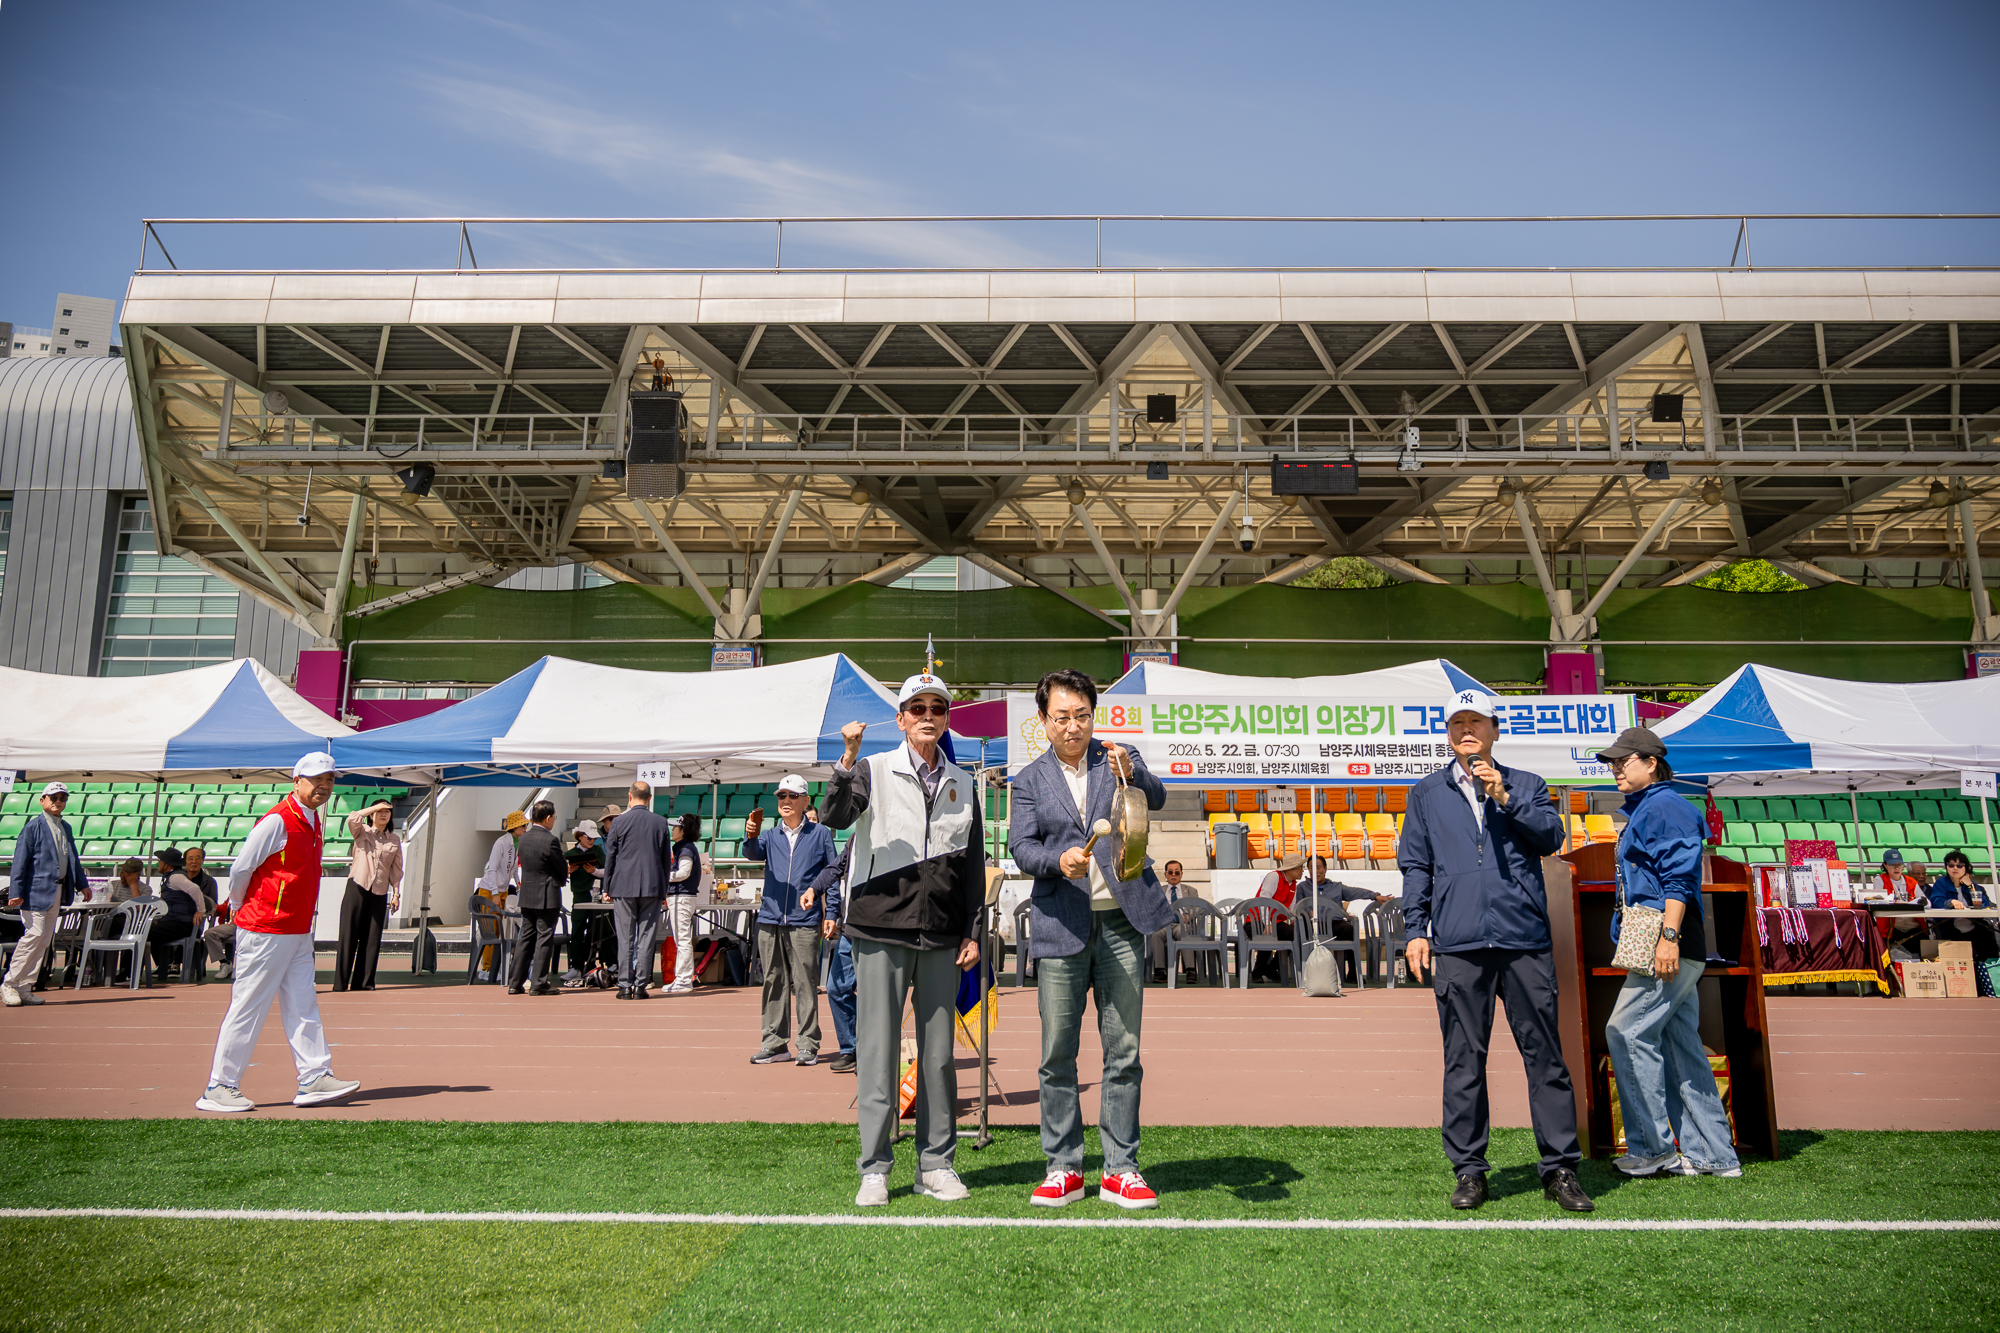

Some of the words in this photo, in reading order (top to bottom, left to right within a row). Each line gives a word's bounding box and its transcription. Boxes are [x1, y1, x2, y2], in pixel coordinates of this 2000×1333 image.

[1460, 691, 1474, 704] NY
[1094, 705, 1142, 727] 제8회
[1151, 703, 1309, 735] 남양주시의회
[1316, 705, 1395, 736] 의장기
[1168, 743, 1203, 756] 2026.
[1205, 744, 1216, 756] 5.
[1221, 744, 1241, 757] 22.
[1244, 744, 1260, 757] 금.
[1264, 744, 1300, 757] 07:30
[1319, 743, 1432, 757] 남양주시체육문화센터
[1173, 764, 1190, 773] 주최
[1197, 762, 1258, 775] 남양주시의회,
[1261, 763, 1330, 775] 남양주시체육회
[1351, 764, 1367, 774] 주관
[1965, 779, 1992, 789] 본부석
